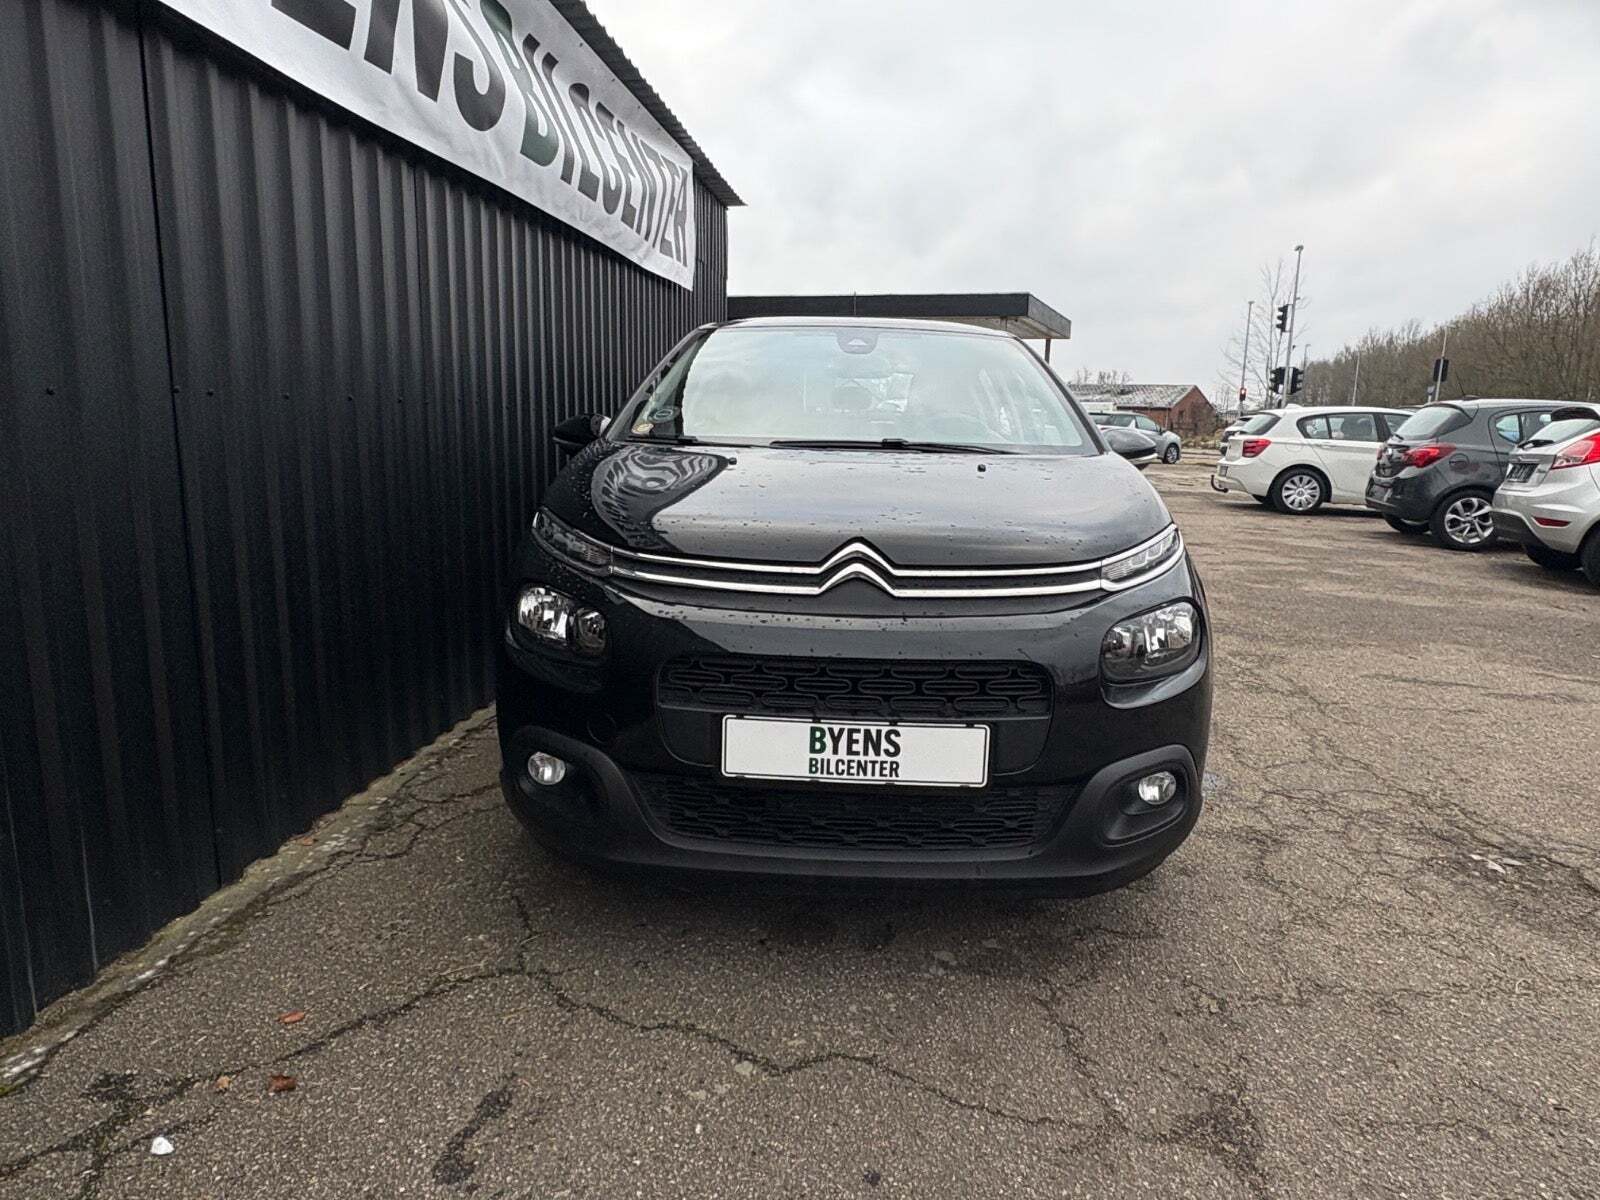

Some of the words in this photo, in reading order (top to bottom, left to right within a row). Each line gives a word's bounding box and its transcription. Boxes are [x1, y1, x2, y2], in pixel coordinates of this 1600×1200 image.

[479, 0, 689, 268] BILCENTER
[809, 726, 901, 758] BYENS
[808, 757, 900, 778] BILCENTER
